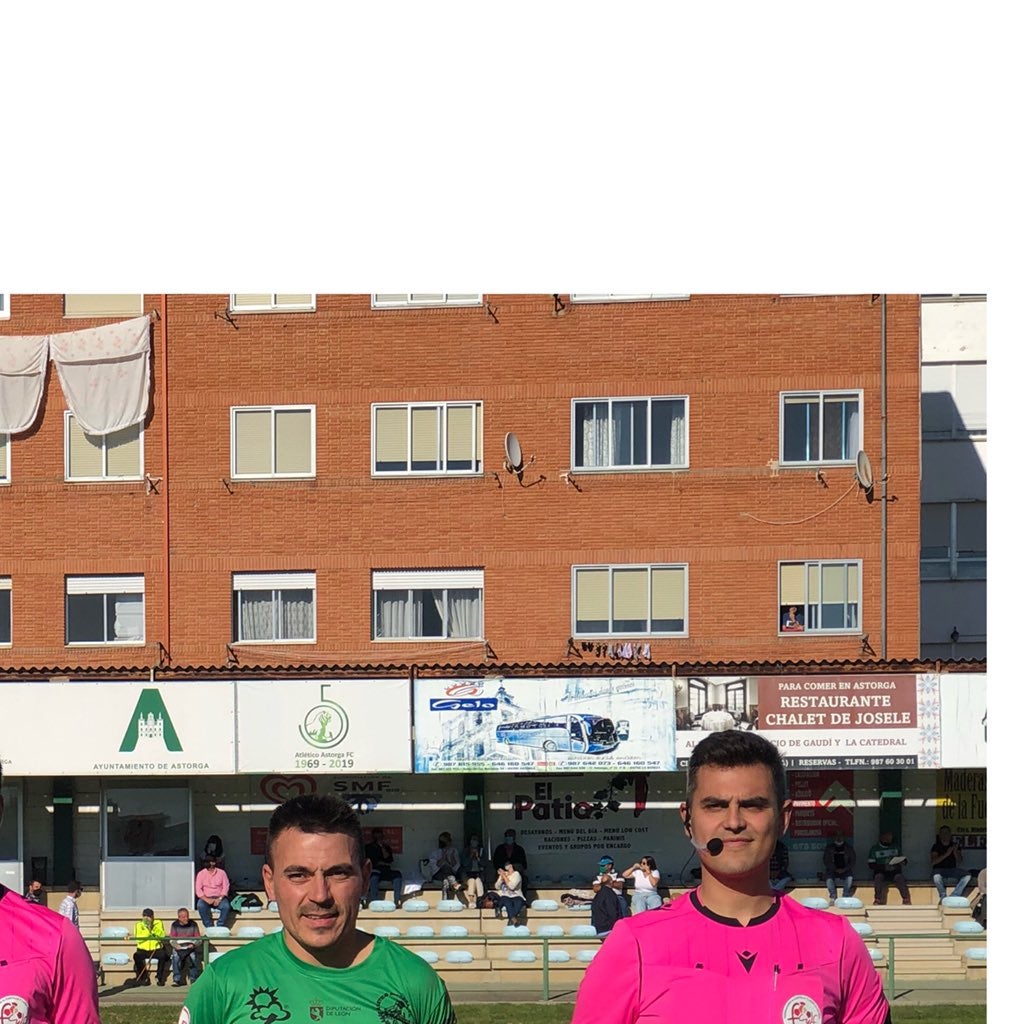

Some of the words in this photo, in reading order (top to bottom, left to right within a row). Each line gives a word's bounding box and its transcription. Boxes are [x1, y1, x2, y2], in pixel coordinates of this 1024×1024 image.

[803, 682, 837, 690] COMER
[838, 682, 851, 690] EN
[853, 681, 896, 689] ASTORGA
[780, 695, 891, 708] RESTAURANTE
[765, 713, 826, 726] CHALET
[830, 713, 851, 725] DE
[854, 712, 911, 725] JOSELE
[788, 739, 801, 747] DE
[803, 738, 833, 747] GAUDÍ
[859, 738, 907, 746] CATEDRAL
[295, 760, 320, 768] 1969
[329, 759, 354, 768] 2019
[333, 781, 391, 791] SMF
[535, 782, 552, 800] El
[515, 794, 593, 820] Patio
